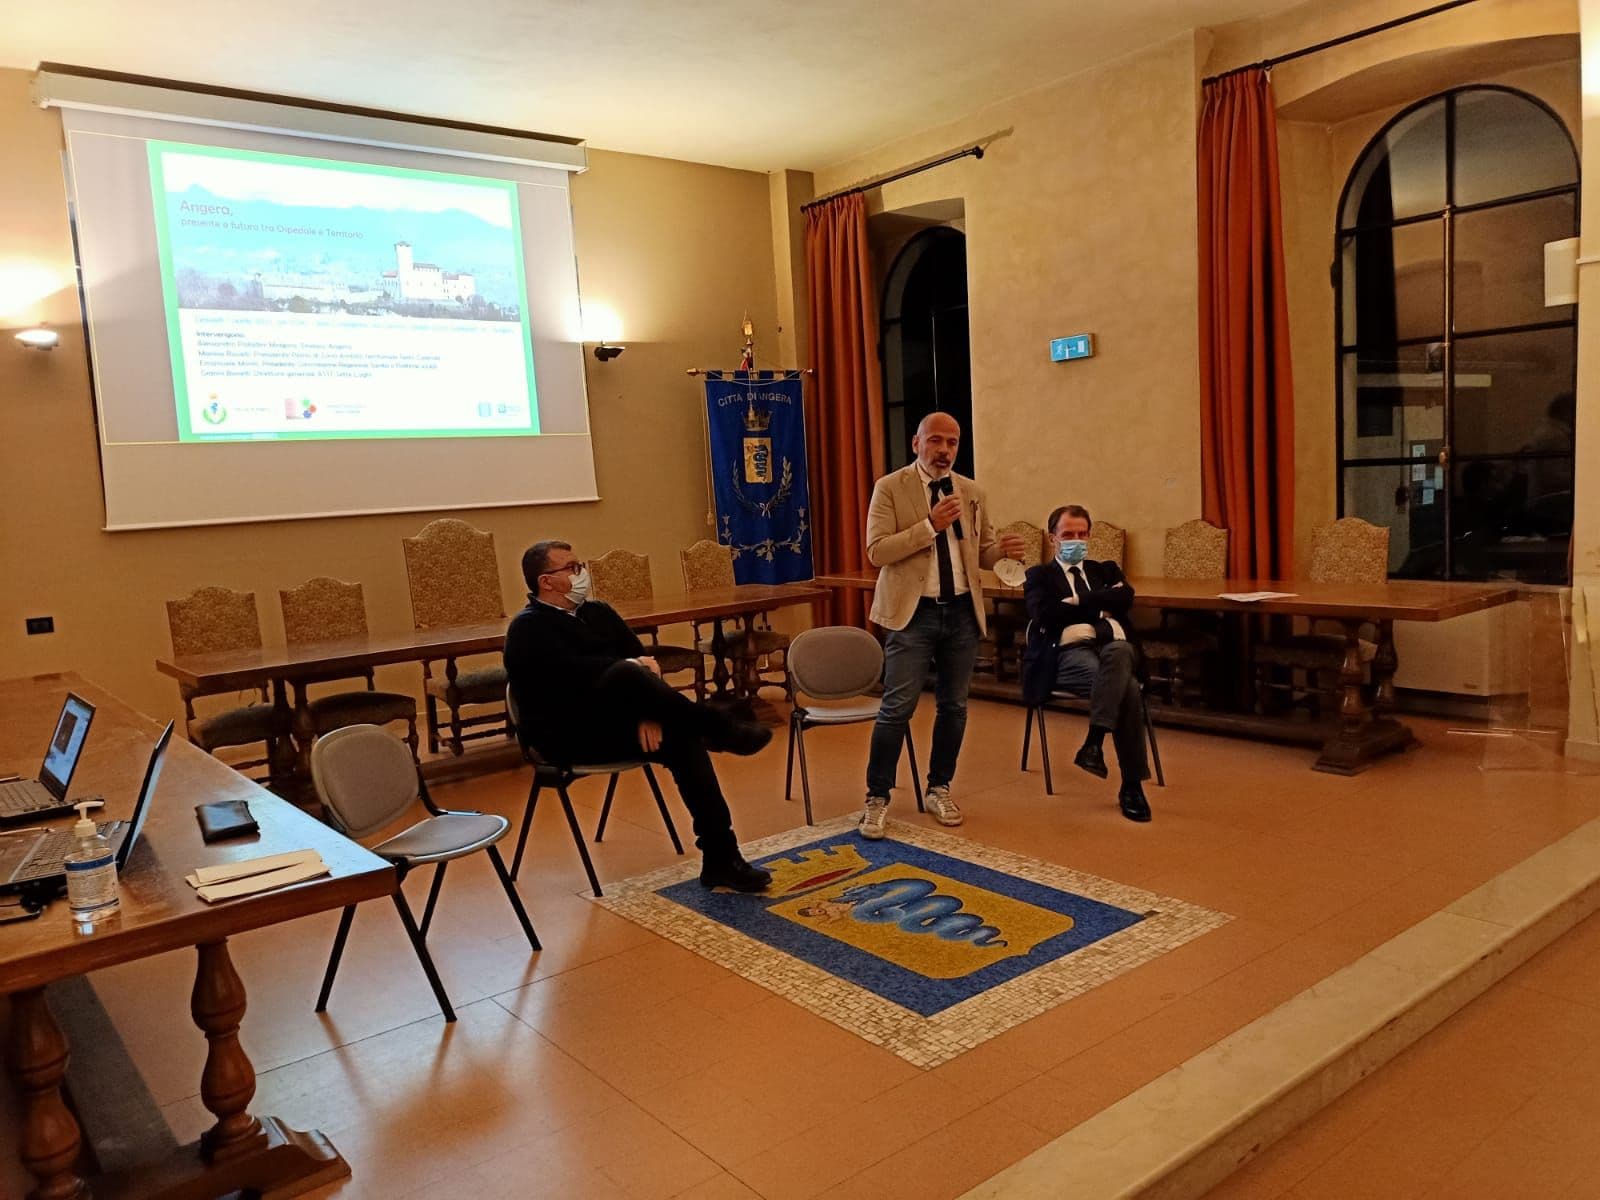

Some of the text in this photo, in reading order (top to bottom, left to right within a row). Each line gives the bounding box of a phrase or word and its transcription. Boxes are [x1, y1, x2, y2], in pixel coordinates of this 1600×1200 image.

[180, 200, 233, 216] Angera,
[181, 218, 220, 229] presente
[231, 221, 259, 232] futuro
[261, 223, 275, 232] tra
[326, 228, 363, 239] Territorio
